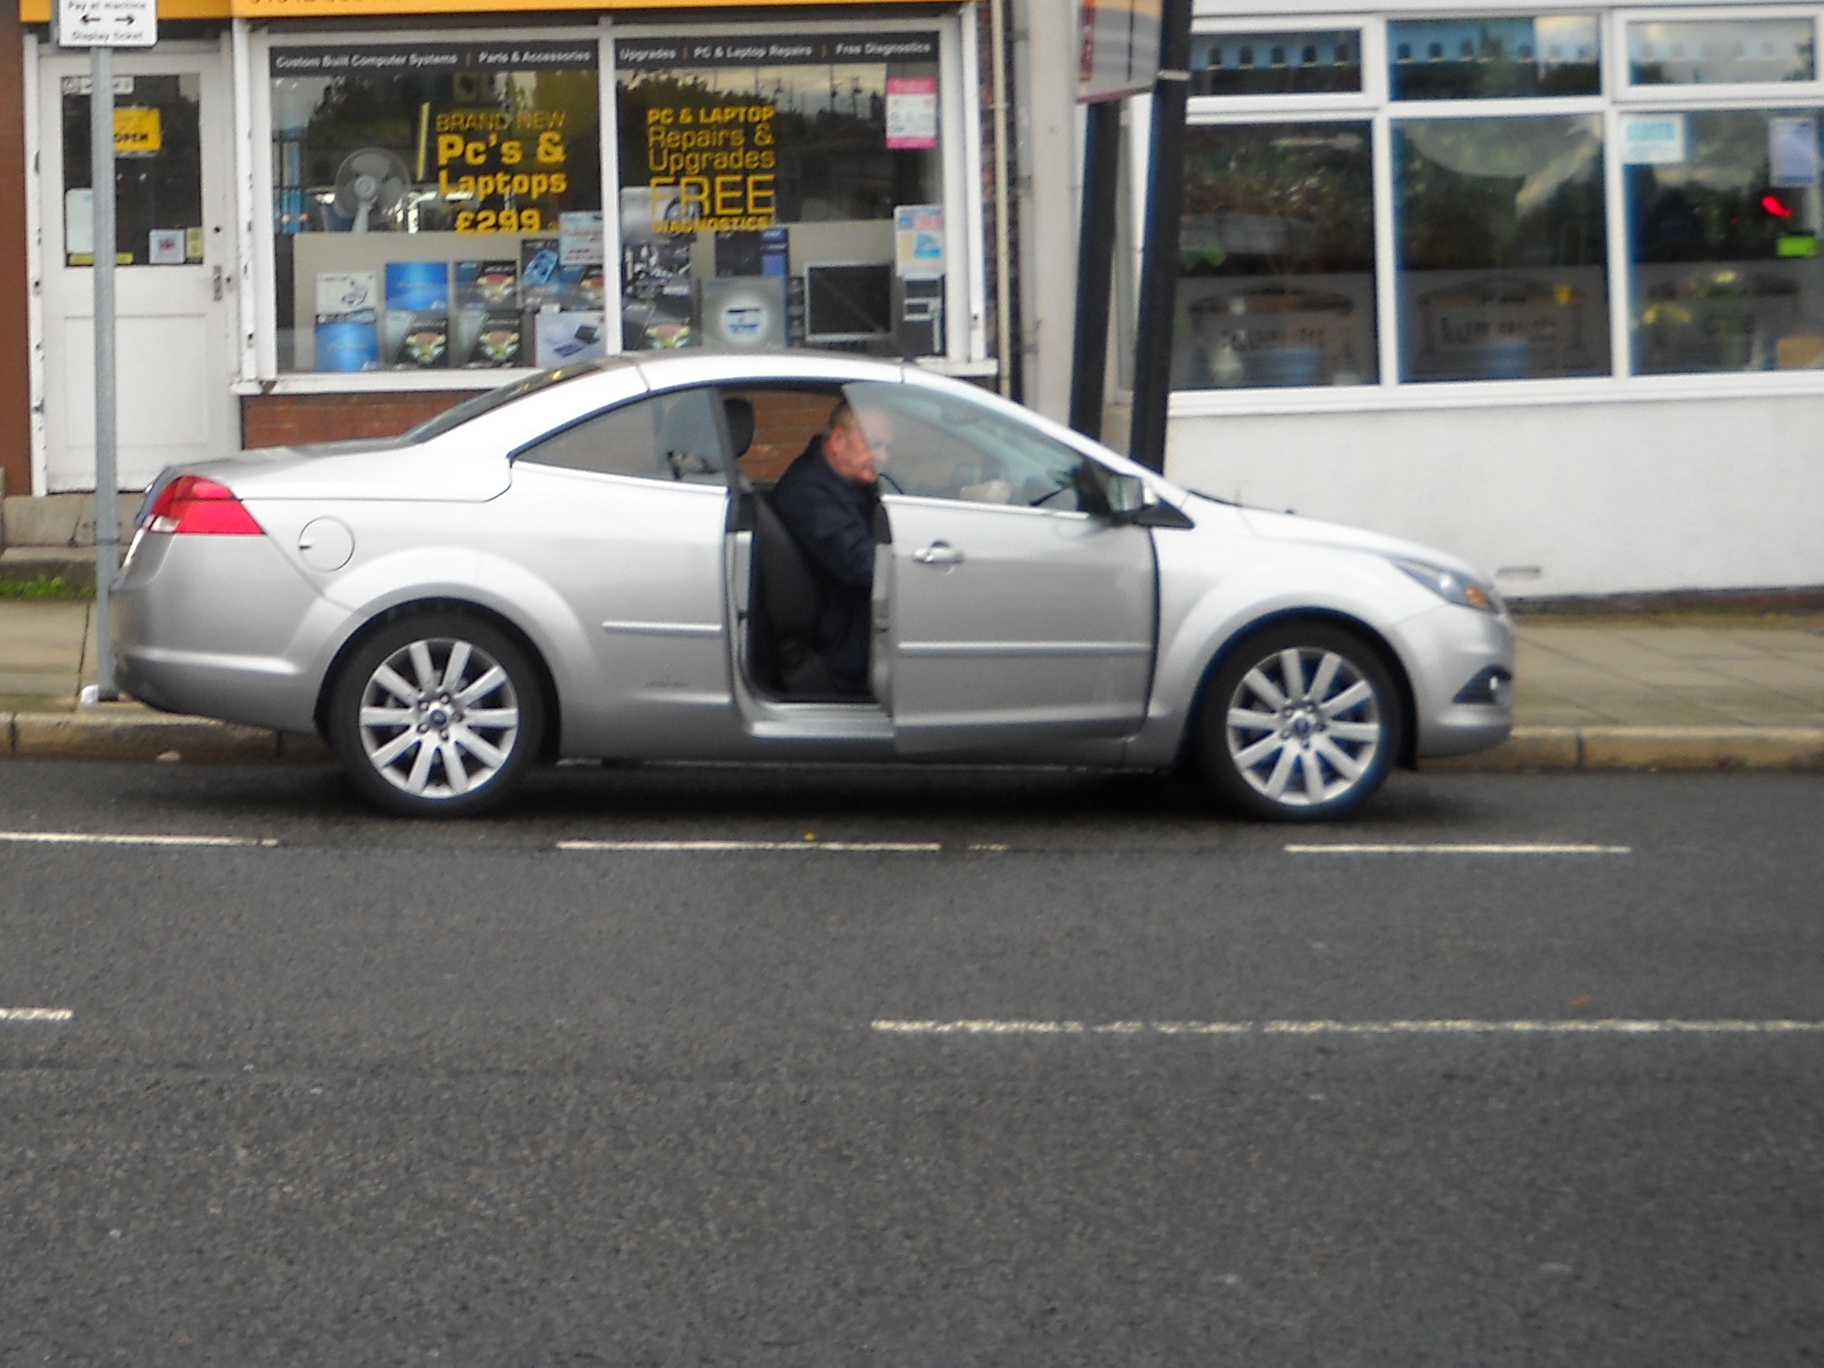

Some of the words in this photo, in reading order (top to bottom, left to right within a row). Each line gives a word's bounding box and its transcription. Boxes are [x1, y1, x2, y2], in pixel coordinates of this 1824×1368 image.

[478, 51, 509, 64] Parts
[521, 50, 591, 63] Accessories
[619, 47, 676, 62] Upgrades
[693, 46, 711, 59] PC
[726, 45, 767, 60] Laptop
[769, 44, 813, 59] Repairs
[836, 43, 862, 55] Free
[864, 42, 931, 57] Diagnostics
[276, 55, 320, 69] Custom
[322, 54, 349, 67] Built
[351, 53, 407, 69] Computer
[409, 52, 458, 68] Systems
[436, 113, 507, 132] BRAND
[517, 110, 567, 130] NEW
[647, 108, 674, 126] PC
[679, 107, 694, 125] &
[699, 105, 775, 124] LAPTOP
[647, 125, 745, 151] Repairs
[753, 124, 775, 148] &
[437, 133, 523, 166] Pc's
[536, 131, 567, 164] &
[648, 148, 775, 176] Upgrades
[438, 171, 568, 200] Laptops
[649, 173, 776, 217] FREE
